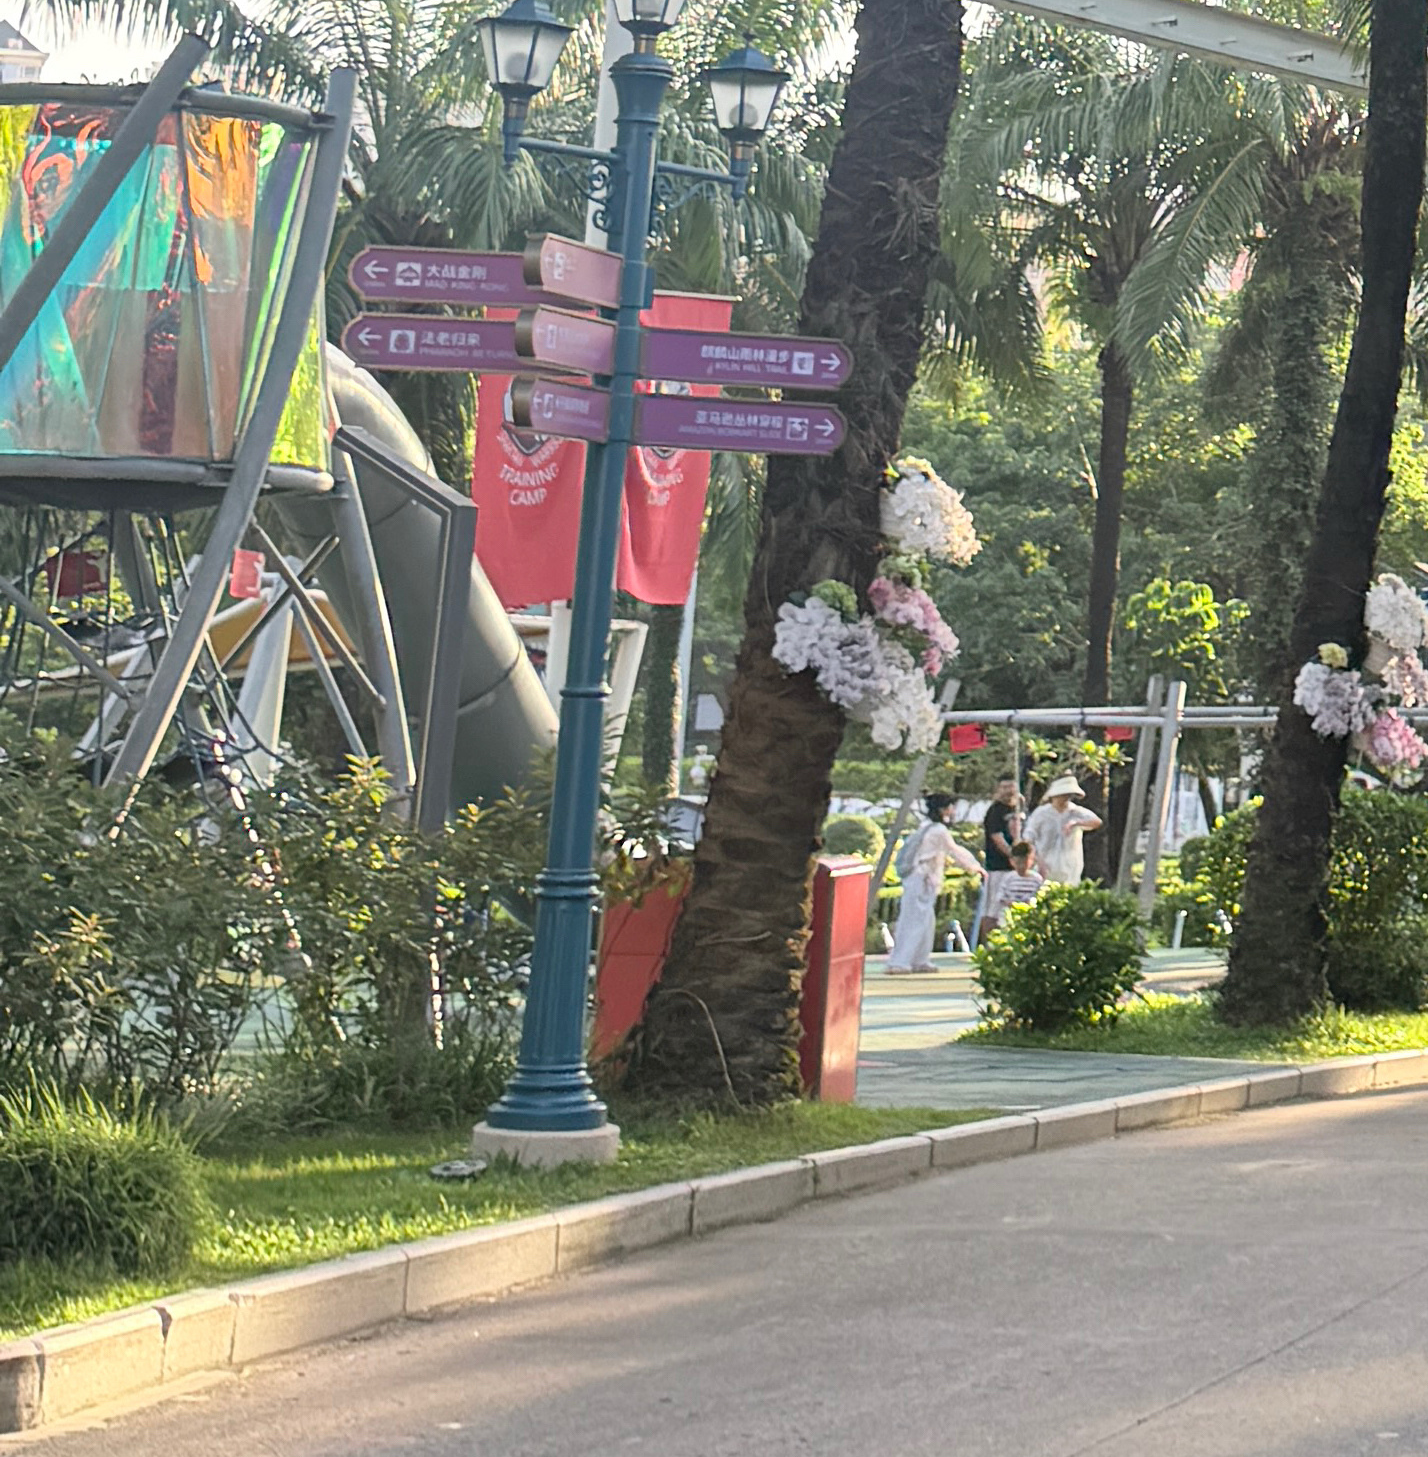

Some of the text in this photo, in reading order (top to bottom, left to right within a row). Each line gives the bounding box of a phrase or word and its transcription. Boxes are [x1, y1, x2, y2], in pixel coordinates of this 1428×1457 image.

[426, 263, 487, 281] 大战金刚
[498, 461, 560, 487] TRAINING
[509, 486, 548, 506] CAMP
